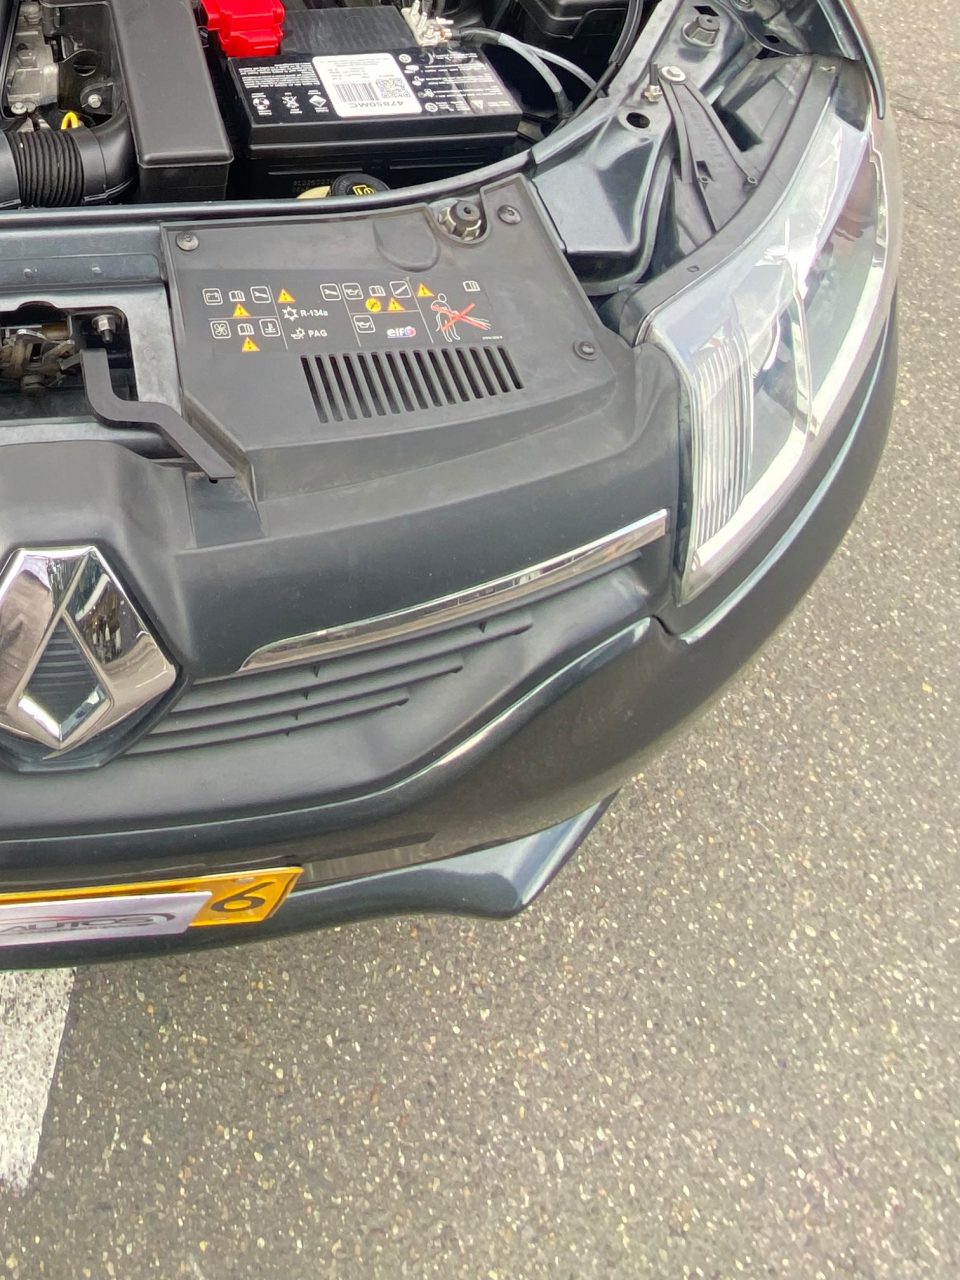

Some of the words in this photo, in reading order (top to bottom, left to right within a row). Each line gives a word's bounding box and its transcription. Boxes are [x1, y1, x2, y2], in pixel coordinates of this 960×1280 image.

[300, 309, 328, 317] R-134a
[308, 329, 327, 337] PAG
[211, 881, 275, 912] 6
